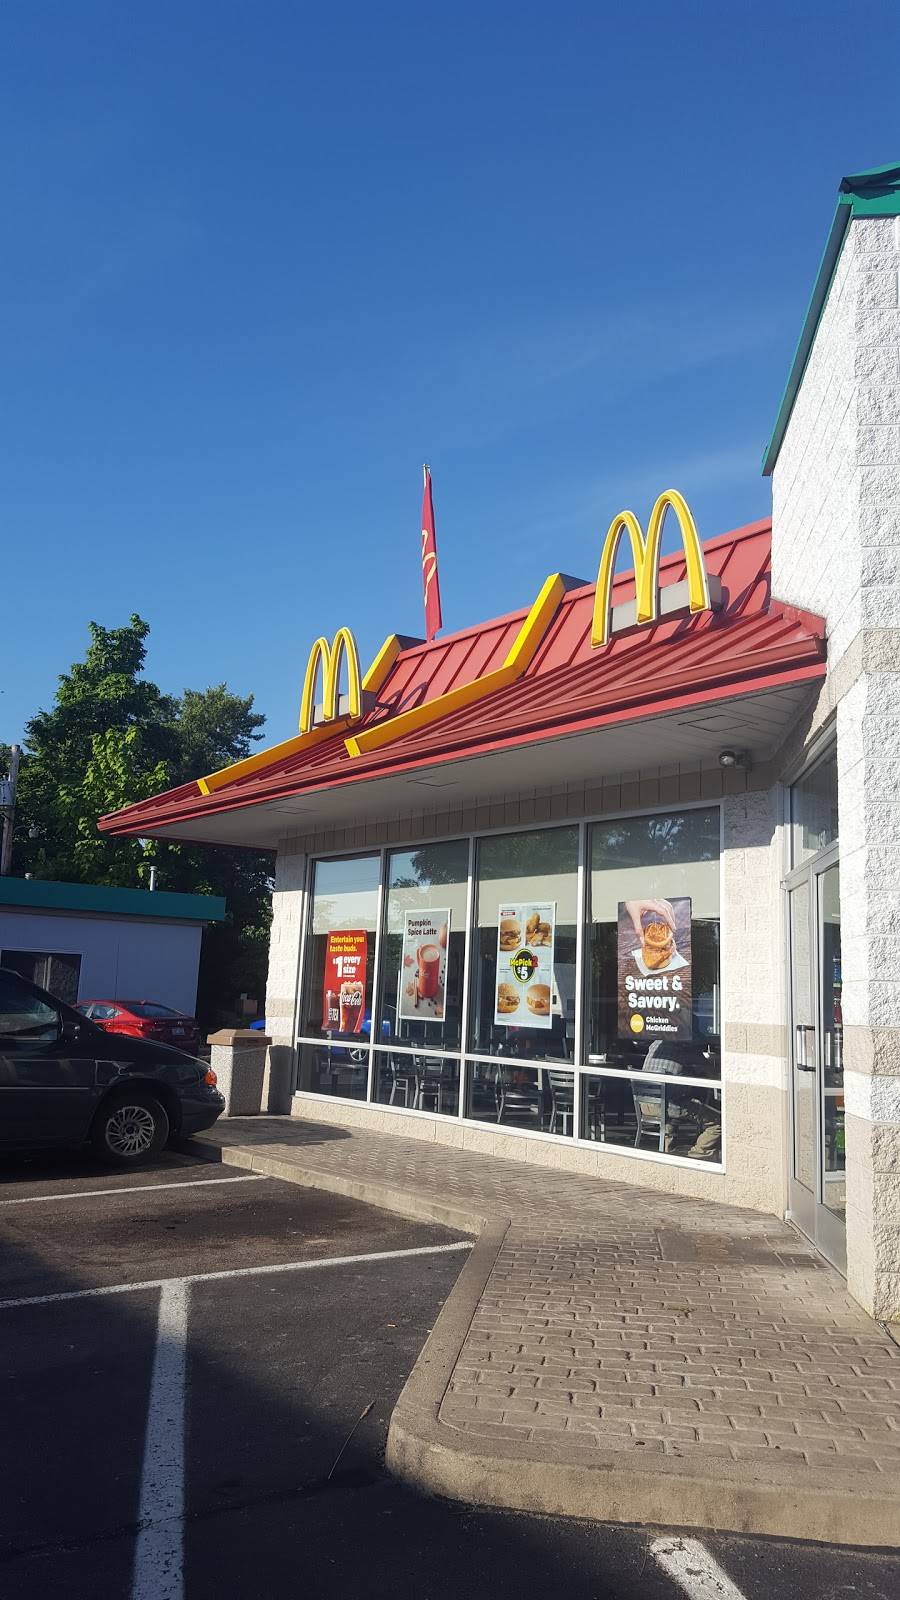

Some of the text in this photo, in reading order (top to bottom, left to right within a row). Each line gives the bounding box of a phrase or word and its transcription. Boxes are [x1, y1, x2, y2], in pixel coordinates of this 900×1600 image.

[408, 919, 432, 928] Pumpkin
[408, 928, 437, 937] Spice Latte
[330, 935, 354, 944] Entertain
[329, 945, 344, 953] taste
[343, 956, 361, 966] every
[509, 957, 533, 968] McPick
[342, 964, 357, 974] size
[625, 975, 683, 991] Sweet &
[628, 992, 680, 1012] Savory.
[645, 1016, 669, 1024] Chicken
[645, 1024, 678, 1032] McGriddles
